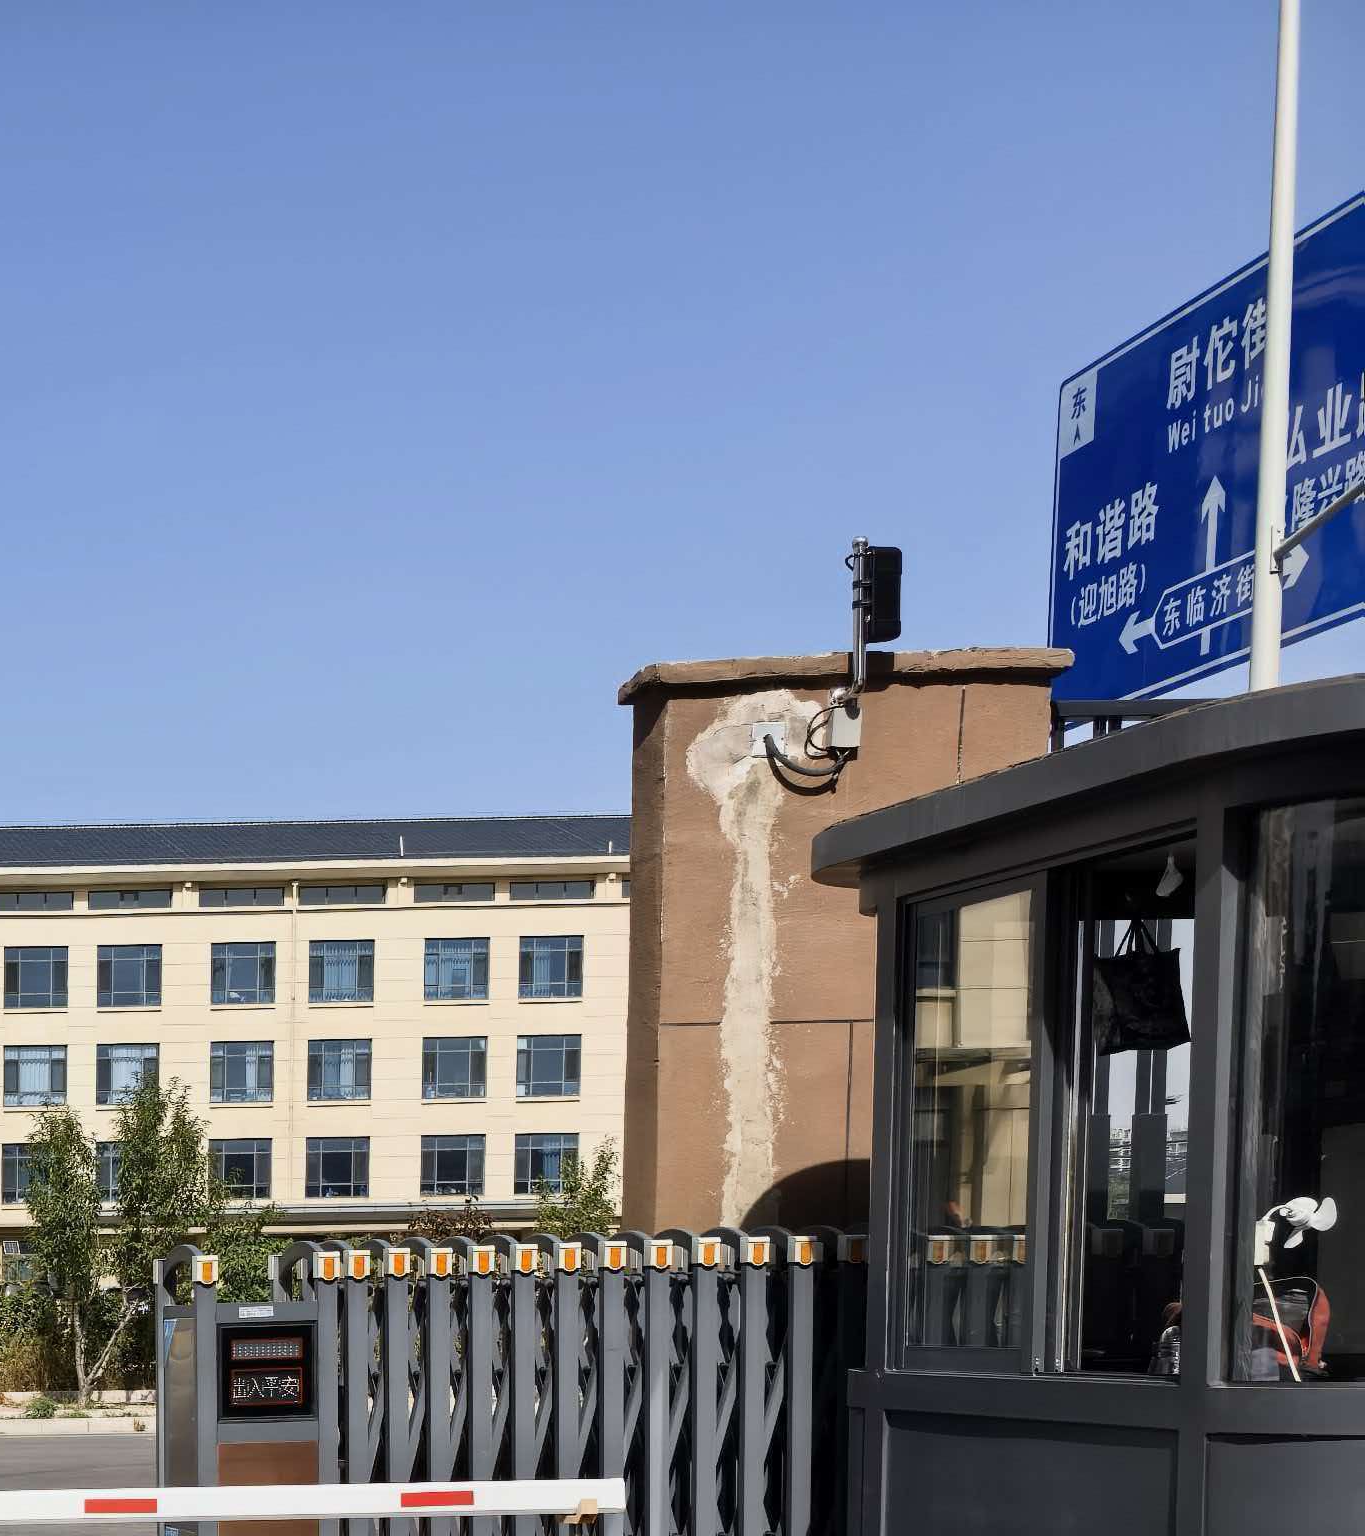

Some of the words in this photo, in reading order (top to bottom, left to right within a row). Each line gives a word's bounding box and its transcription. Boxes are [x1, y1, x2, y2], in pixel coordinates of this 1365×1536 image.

[1070, 385, 1088, 421] 东
[1167, 409, 1197, 454] Wei
[1203, 397, 1235, 434] tuo
[1240, 375, 1265, 413] Ji
[1063, 481, 1159, 581] 和谐路
[232, 1375, 299, 1399] 出入平安
